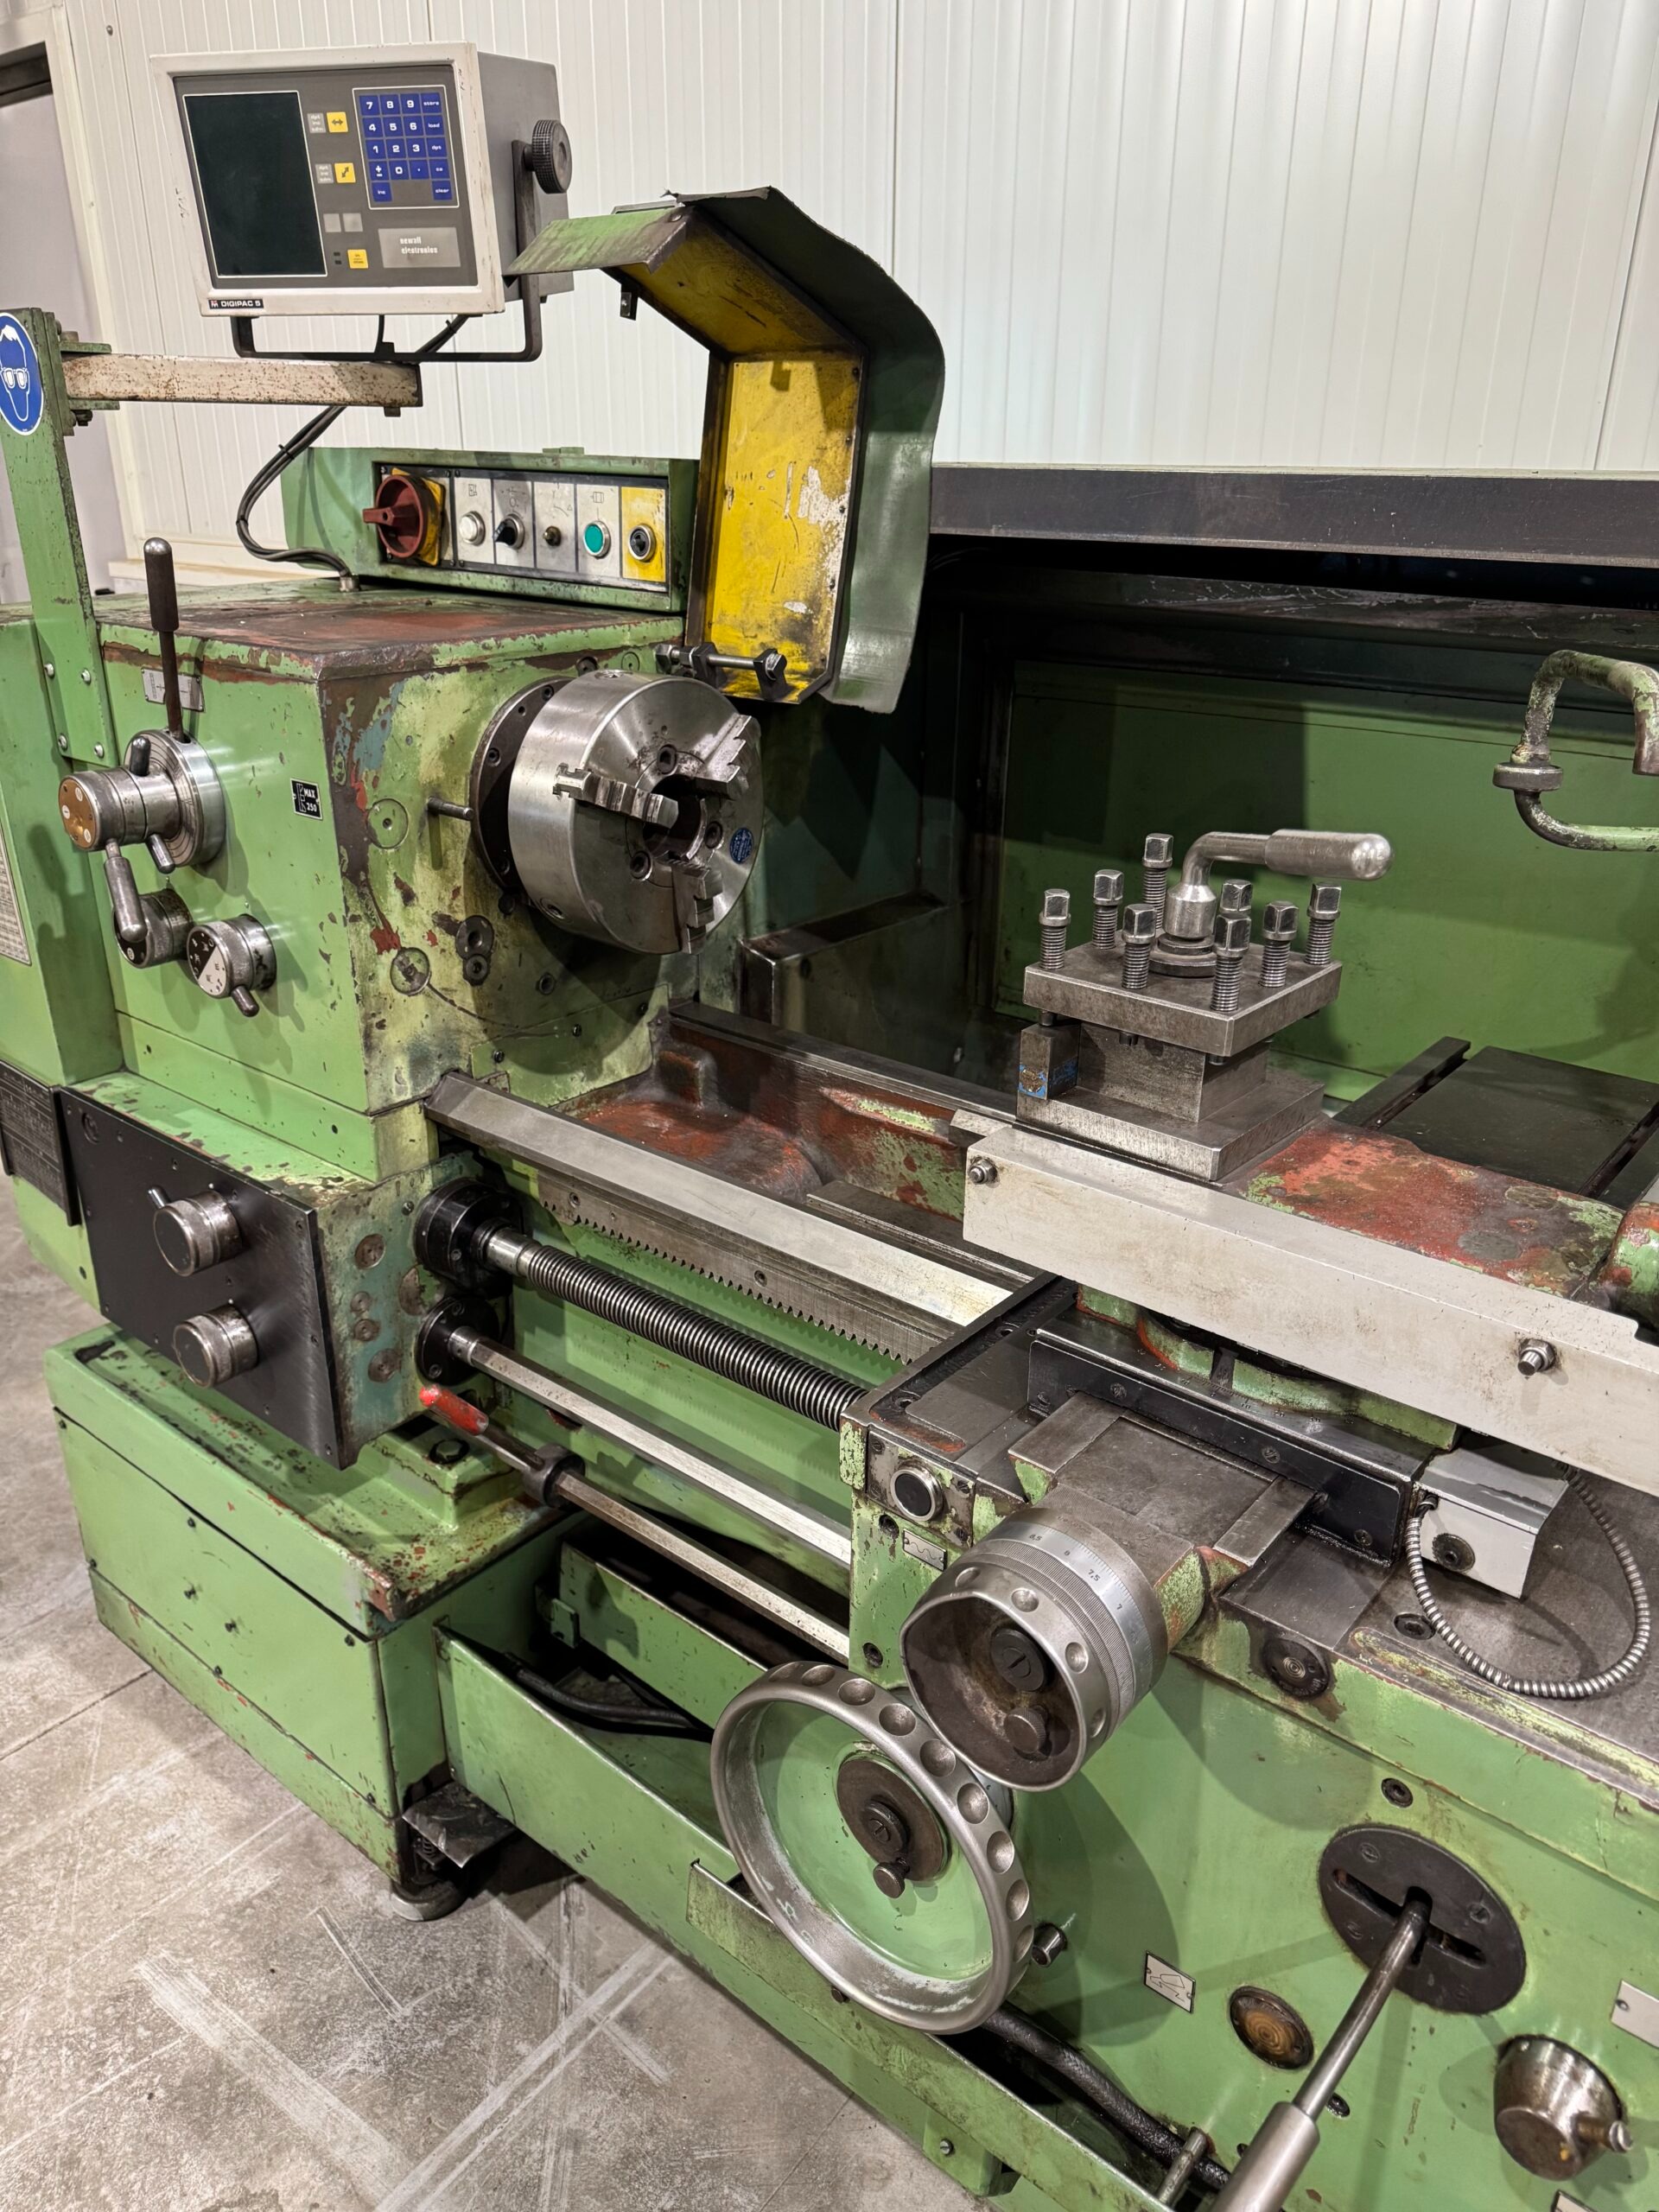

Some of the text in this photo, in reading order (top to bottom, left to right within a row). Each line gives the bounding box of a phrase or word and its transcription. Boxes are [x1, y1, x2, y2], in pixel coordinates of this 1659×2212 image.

[390, 123, 397, 131] 5
[372, 145, 378, 154] 1
[399, 236, 422, 245] newall
[303, 788, 315, 798] MAX
[306, 802, 317, 812] 250
